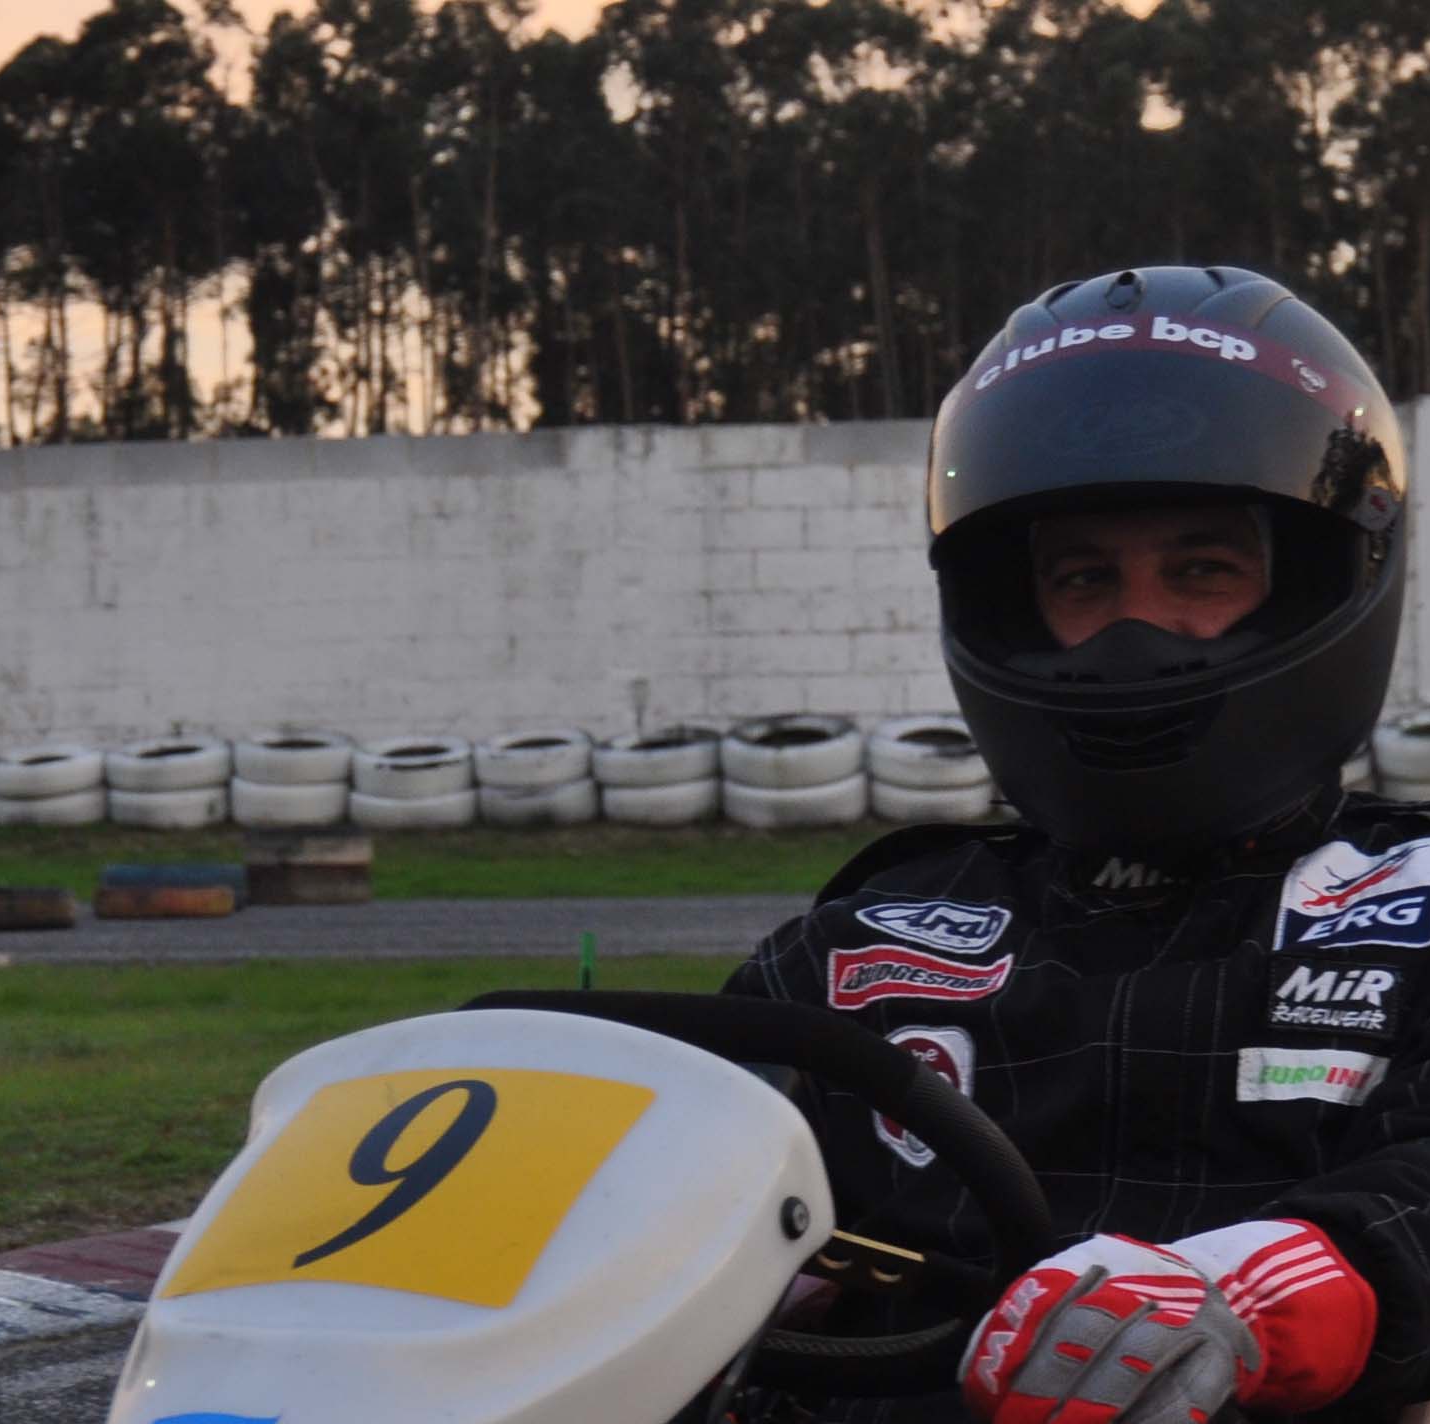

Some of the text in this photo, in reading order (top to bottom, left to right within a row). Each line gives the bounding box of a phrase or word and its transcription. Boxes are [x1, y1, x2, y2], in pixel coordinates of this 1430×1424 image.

[975, 316, 1258, 392] clube bcp
[1297, 896, 1427, 943] ERG
[292, 1078, 498, 1270] 9
